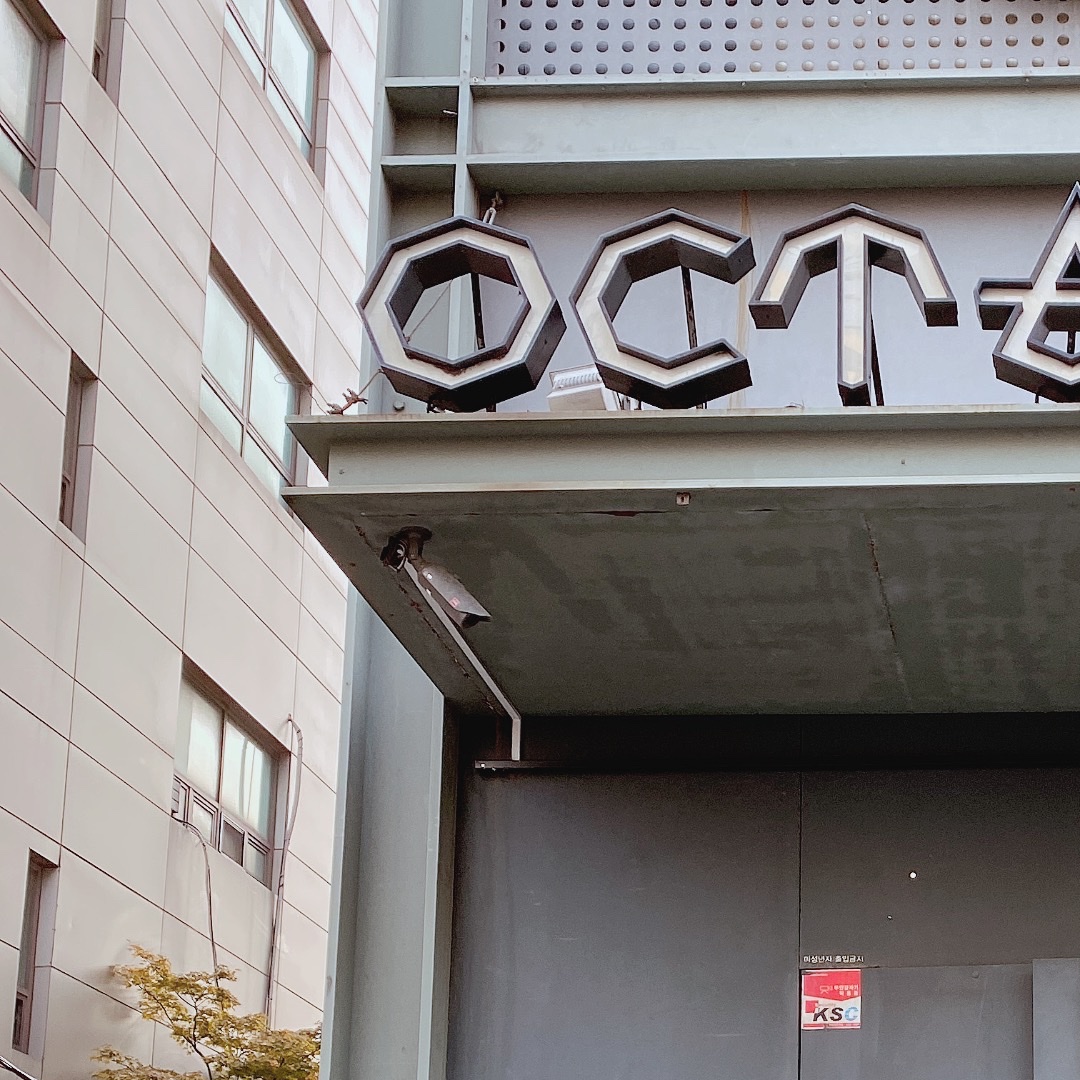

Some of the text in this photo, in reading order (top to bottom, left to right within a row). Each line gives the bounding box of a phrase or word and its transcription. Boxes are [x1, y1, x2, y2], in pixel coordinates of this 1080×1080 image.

[803, 955, 865, 964] 미성년자 출입금지
[813, 1006, 859, 1022] KSC
